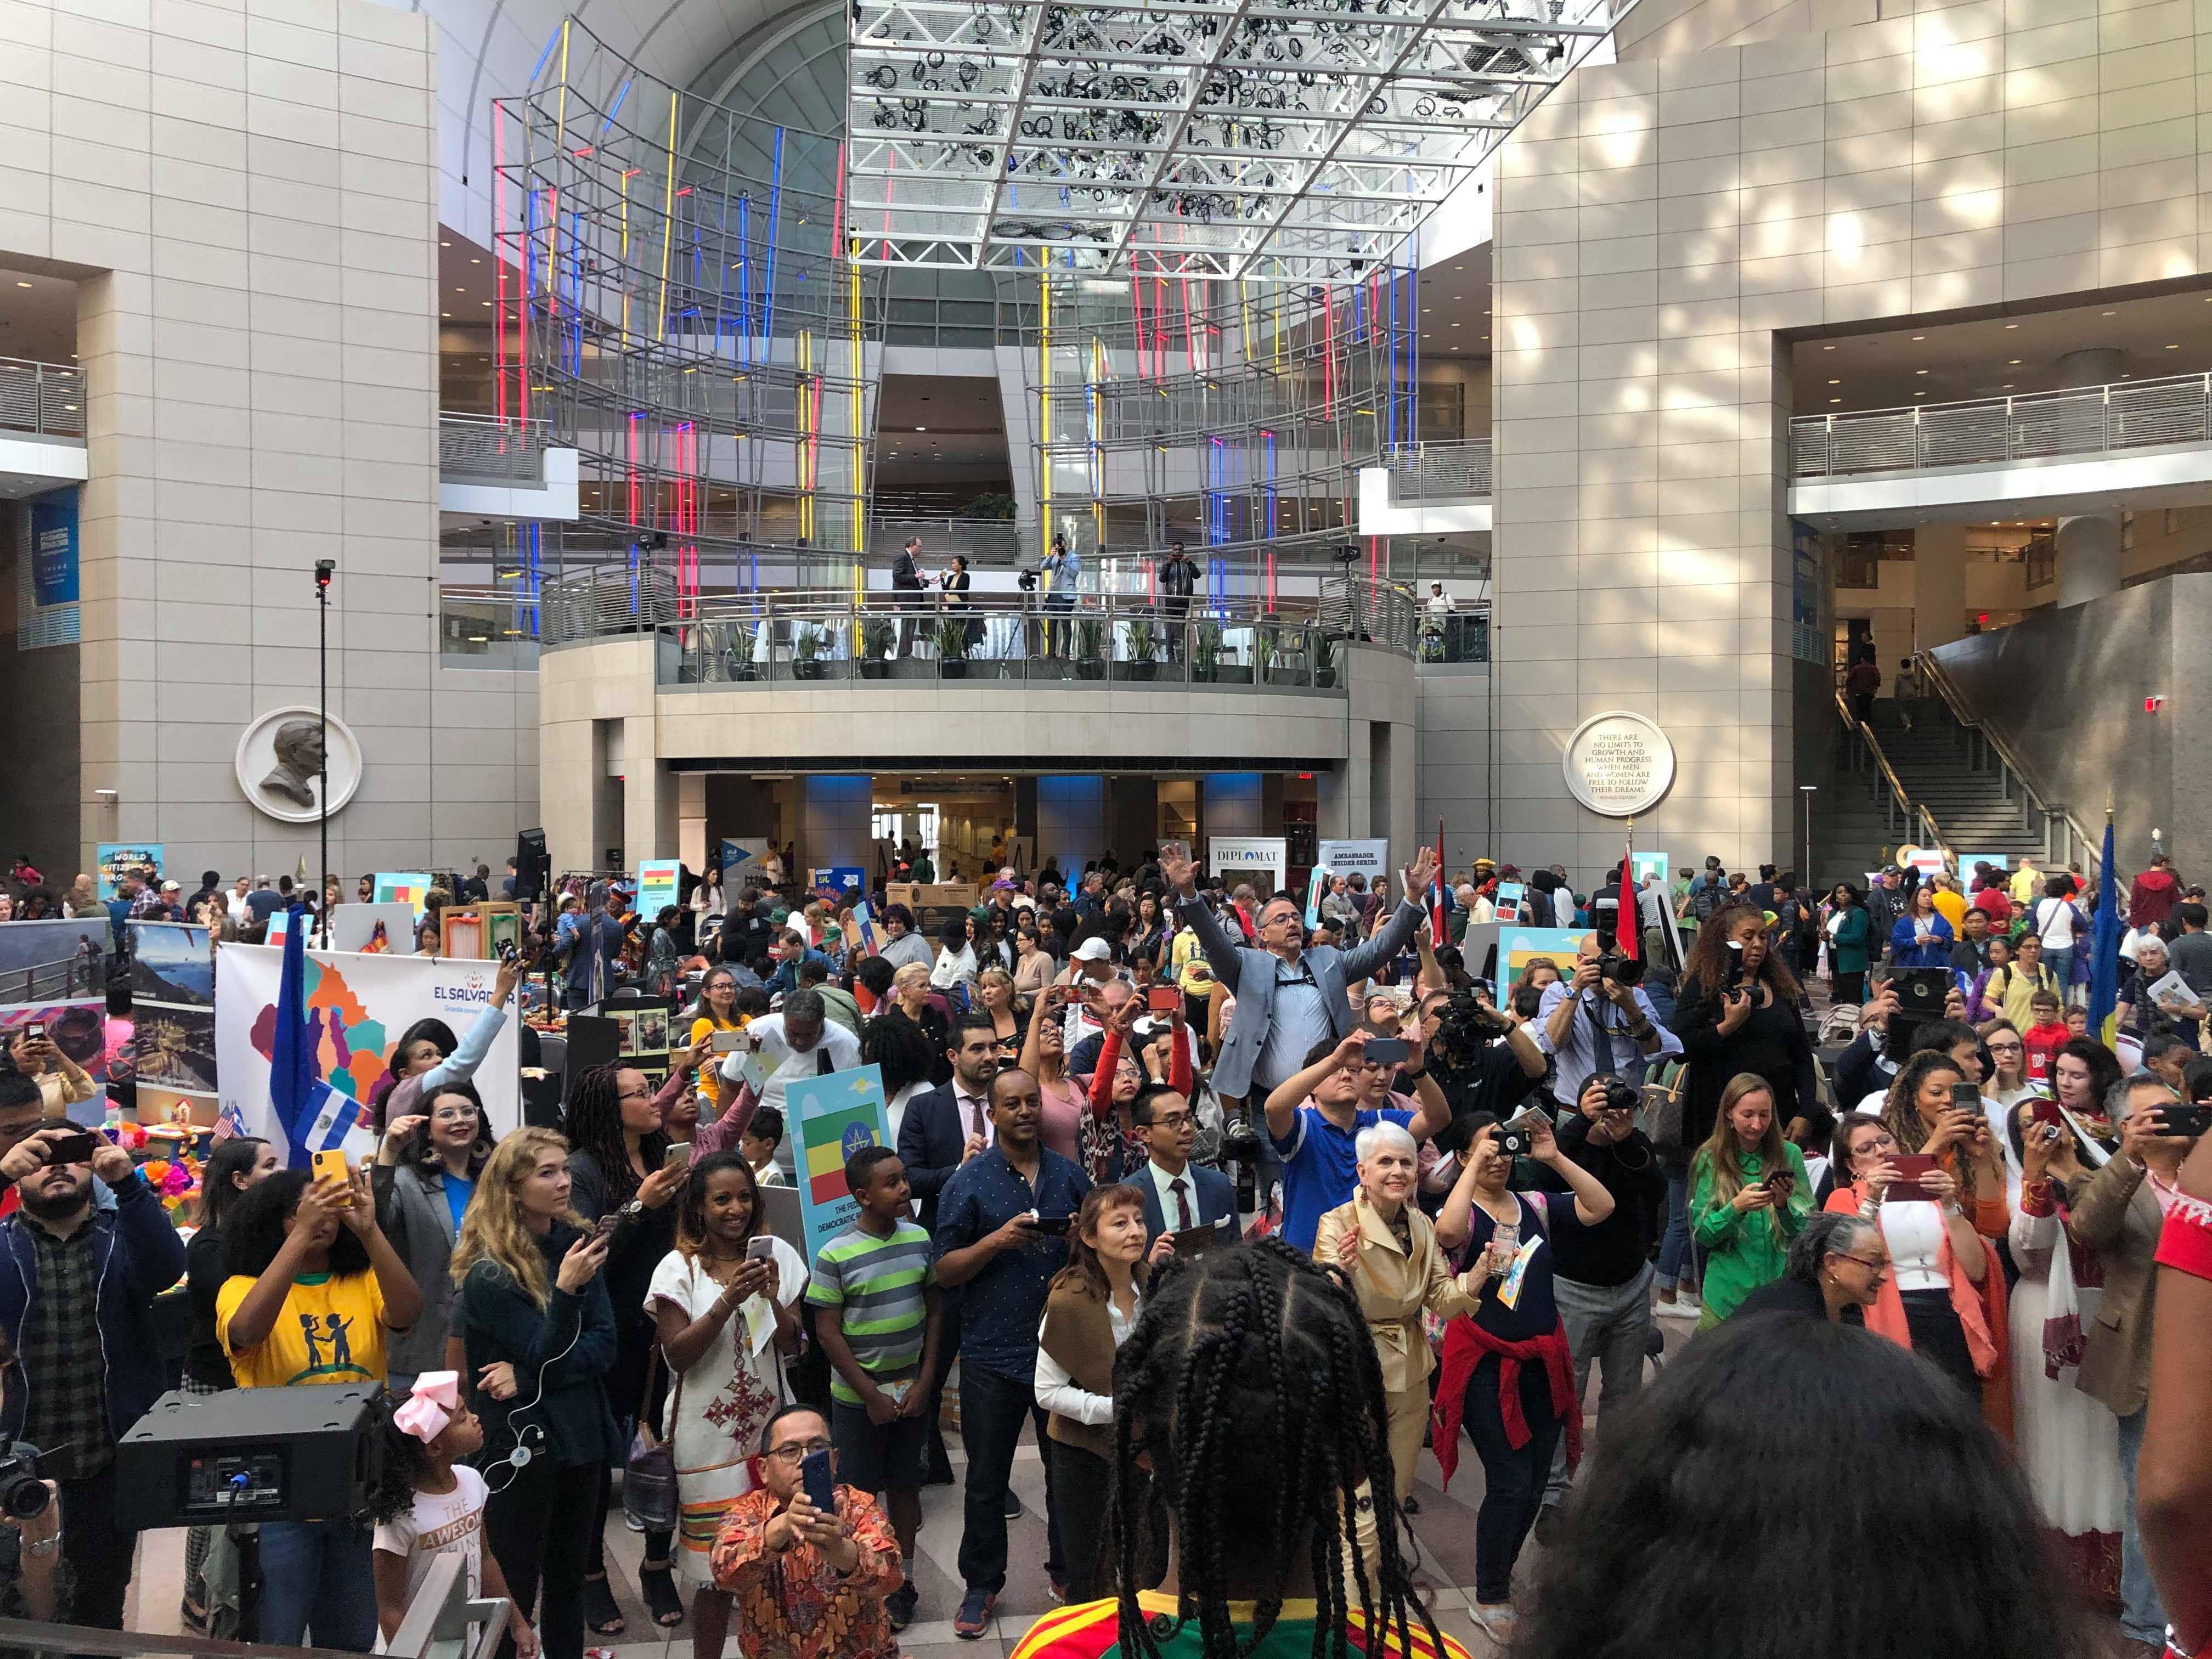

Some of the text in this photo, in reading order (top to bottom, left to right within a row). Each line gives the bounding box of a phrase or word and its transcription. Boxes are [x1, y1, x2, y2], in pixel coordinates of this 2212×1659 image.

[1217, 851, 1278, 861] DIPLOMAT
[99, 873, 123, 882] THRO
[434, 987, 515, 1005] EL SALVAR
[835, 1201, 861, 1214] THE FED
[818, 1214, 856, 1233] DEMOCRATIC
[443, 1498, 470, 1520] THE
[424, 1510, 483, 1548] AWESOM
